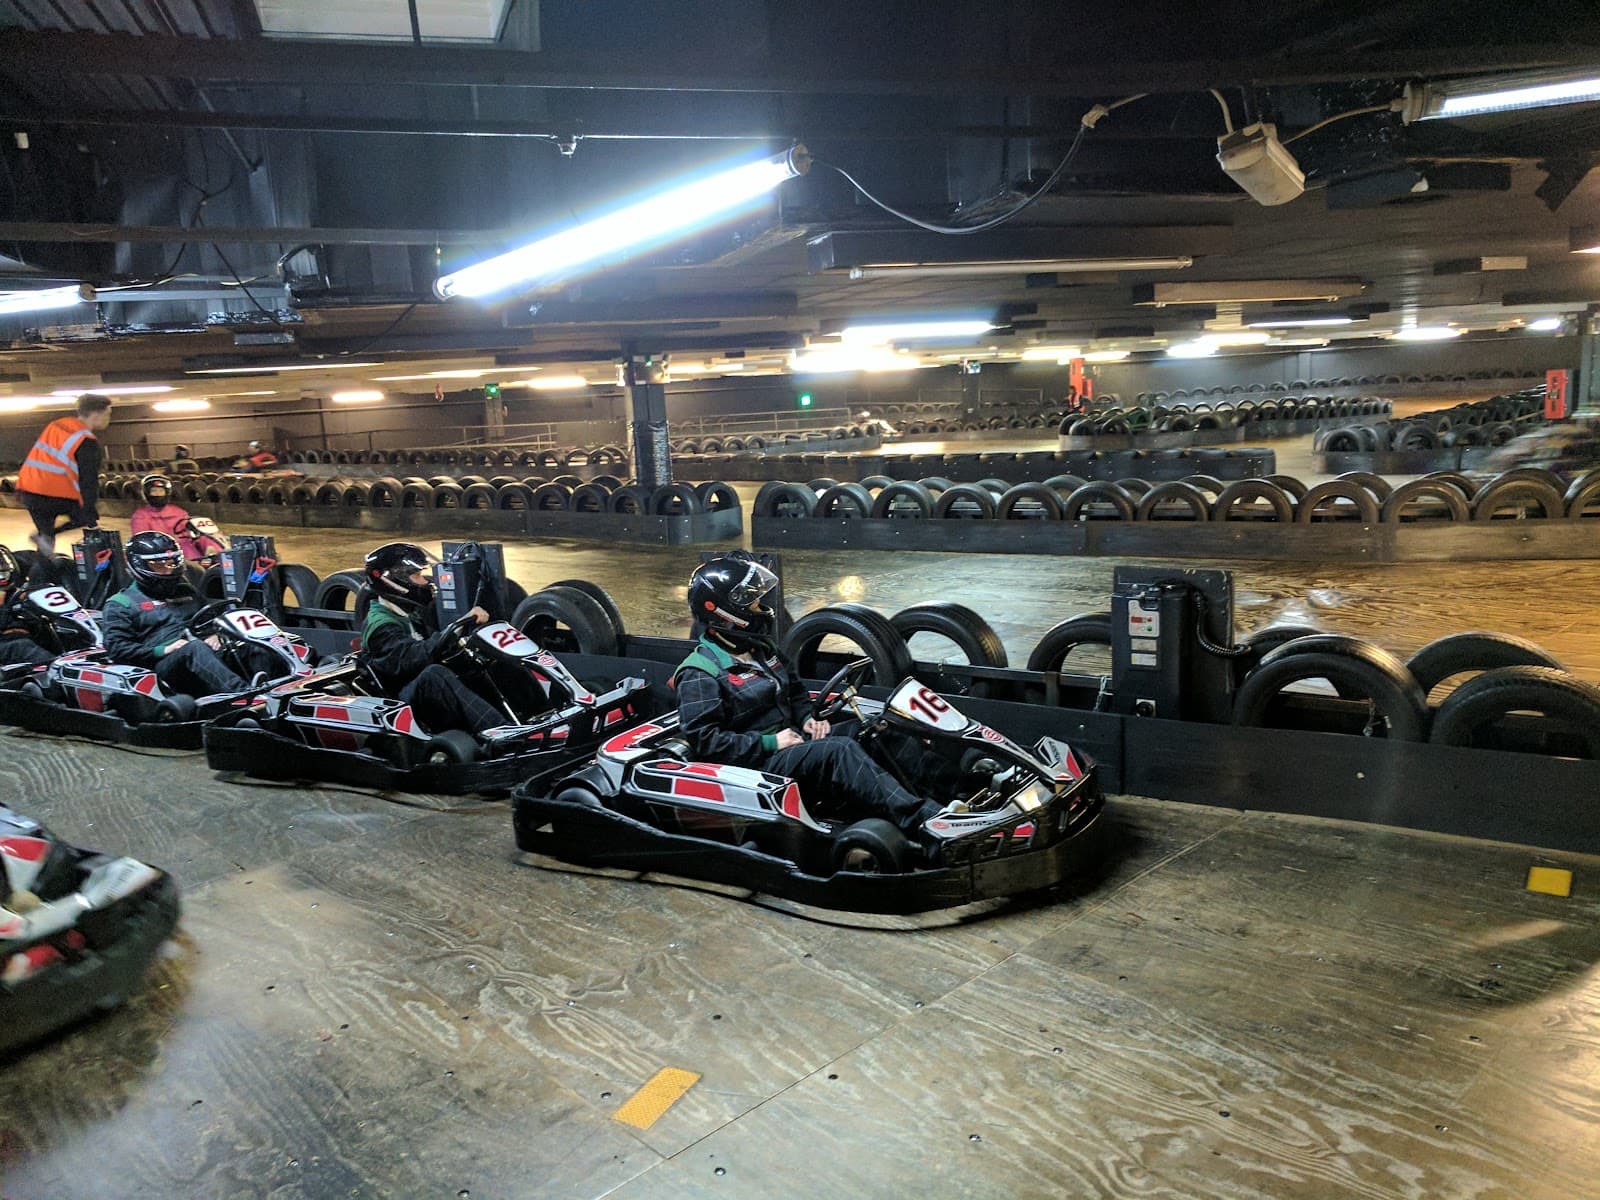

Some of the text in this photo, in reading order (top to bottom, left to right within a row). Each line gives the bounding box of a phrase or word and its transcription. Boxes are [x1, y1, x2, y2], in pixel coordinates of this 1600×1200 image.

[44, 591, 70, 607] 3
[236, 614, 272, 631] 12
[491, 628, 527, 648] 22
[908, 687, 950, 723] 16
